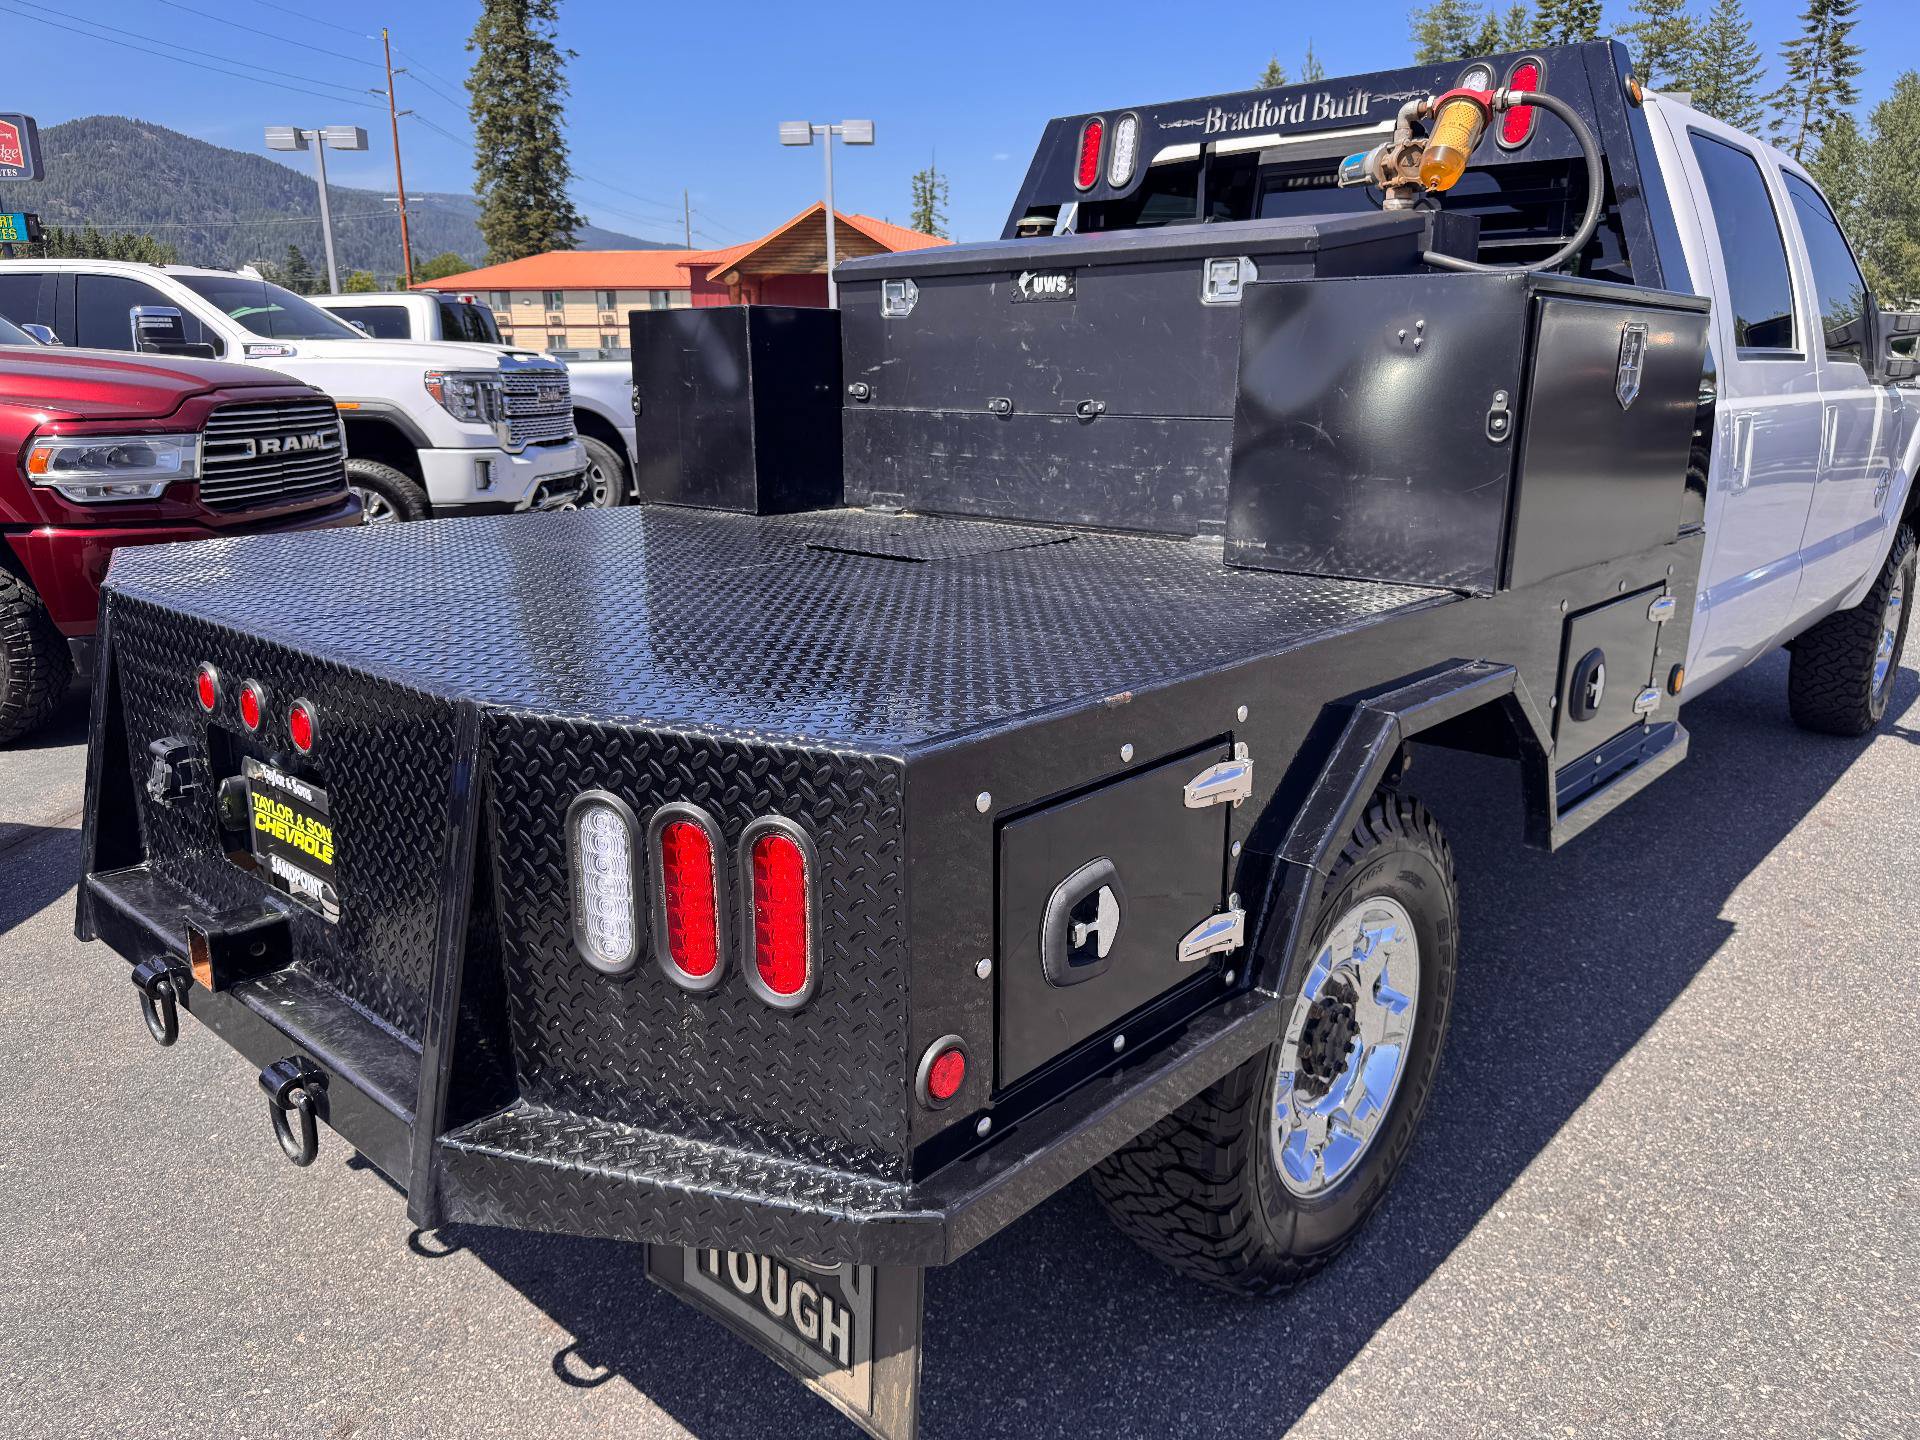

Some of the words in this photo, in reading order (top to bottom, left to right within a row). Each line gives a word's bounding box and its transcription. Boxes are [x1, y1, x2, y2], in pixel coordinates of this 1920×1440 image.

[1202, 94, 1307, 134] Bradford
[1311, 88, 1371, 121] Built
[1034, 275, 1067, 293] UWS
[261, 434, 319, 454] RAM
[252, 792, 293, 823] TAYLOR
[297, 814, 304, 831] &
[306, 817, 333, 843] SON
[255, 812, 334, 865] CHEVROLE
[272, 856, 324, 898] SANDPOINT
